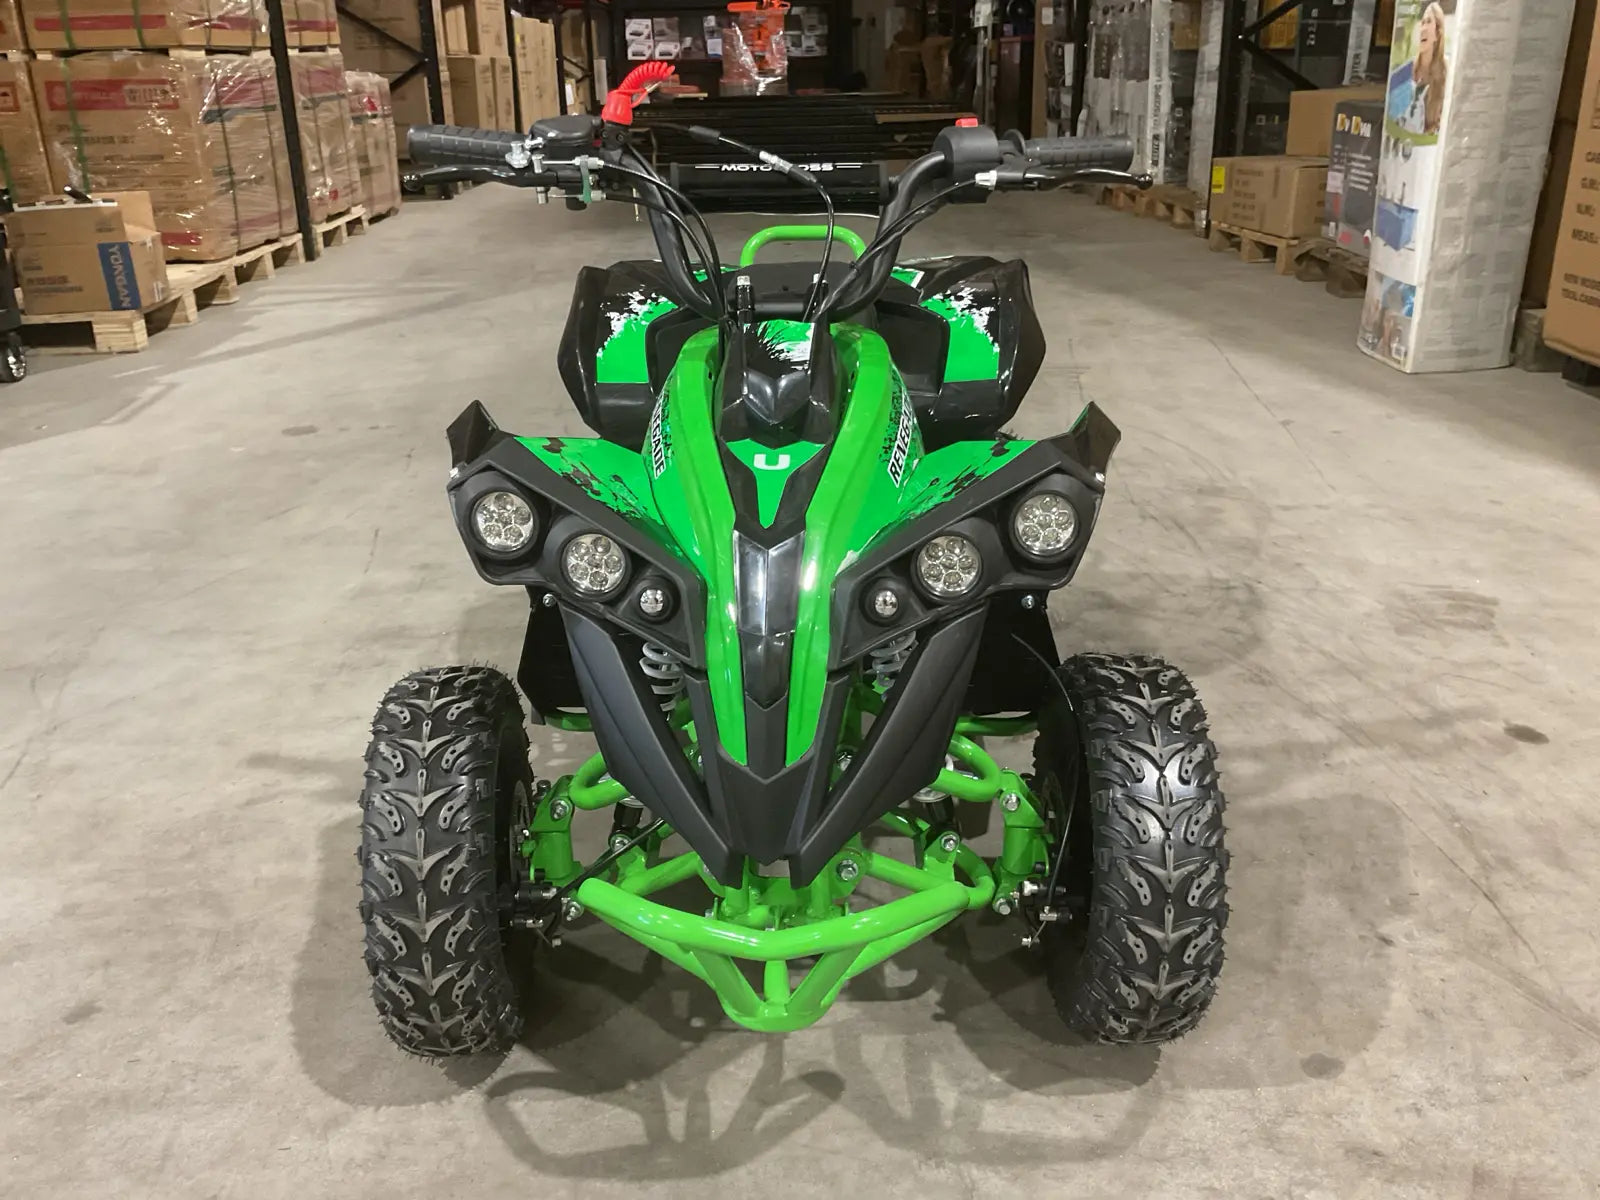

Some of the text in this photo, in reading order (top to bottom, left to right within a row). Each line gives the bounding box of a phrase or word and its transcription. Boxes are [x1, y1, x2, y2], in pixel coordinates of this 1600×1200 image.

[721, 163, 834, 172] MOTOOSS
[652, 400, 666, 478] NEGADE
[889, 388, 912, 487] RENEGA
